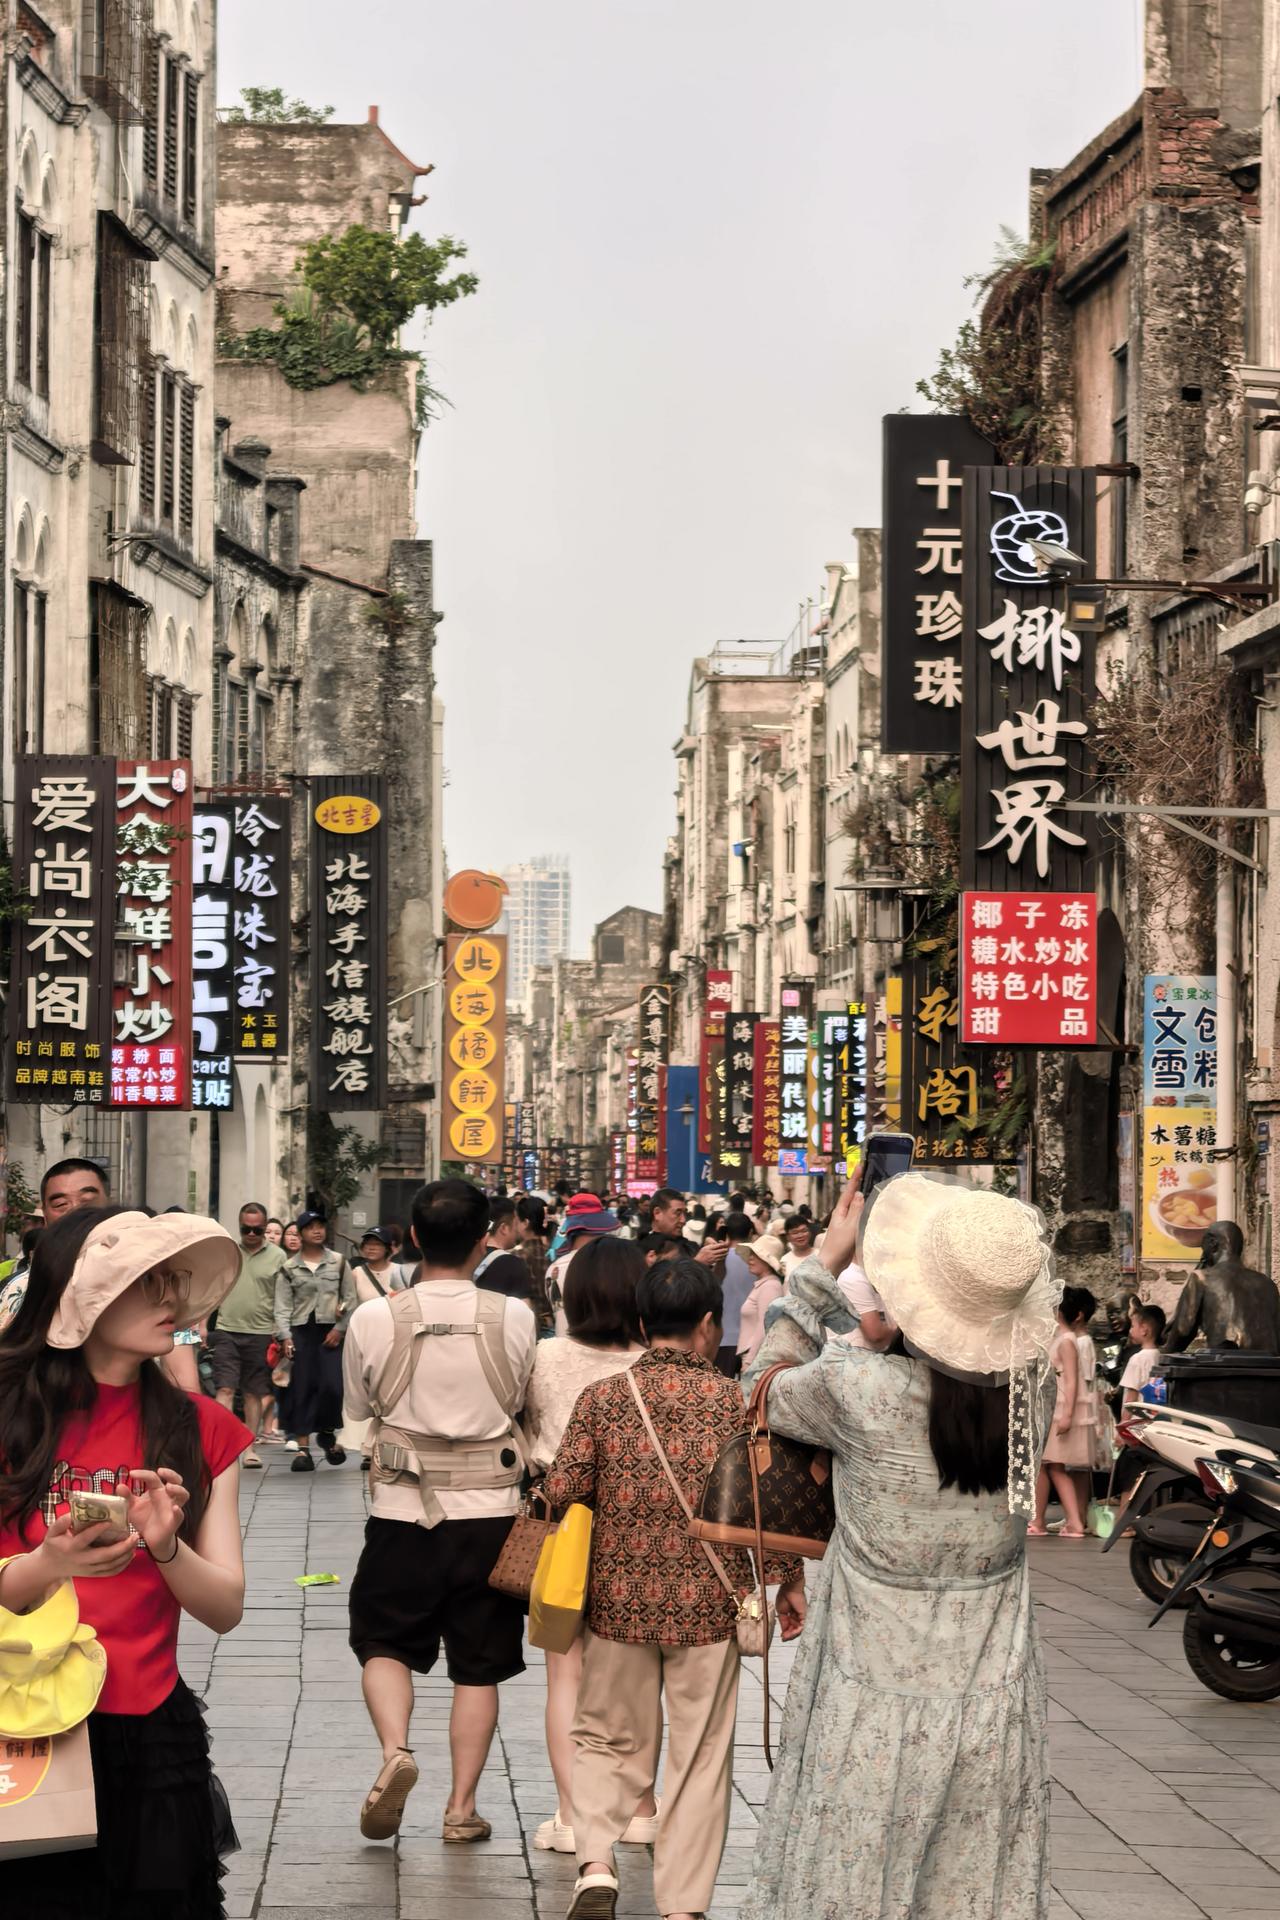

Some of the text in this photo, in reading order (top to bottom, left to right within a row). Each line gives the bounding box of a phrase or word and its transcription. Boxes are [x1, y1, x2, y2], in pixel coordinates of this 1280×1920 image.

[916, 459, 963, 708] 十元珍珠
[975, 599, 1087, 878] 椰世界
[26, 777, 96, 1030] 爱尚衣阁
[971, 900, 1089, 930] 椰子冻
[323, 853, 373, 1093] 北海手信旗舰店
[971, 971, 1090, 1001] 特色小吃
[971, 1007, 1088, 1037] 甜品
[16, 1040, 101, 1059] 时尚服饰
[15, 1067, 104, 1087] 品牌越南鞋
[781, 1015, 808, 1138] 美丽传说
[73, 1089, 103, 1102] 总店
